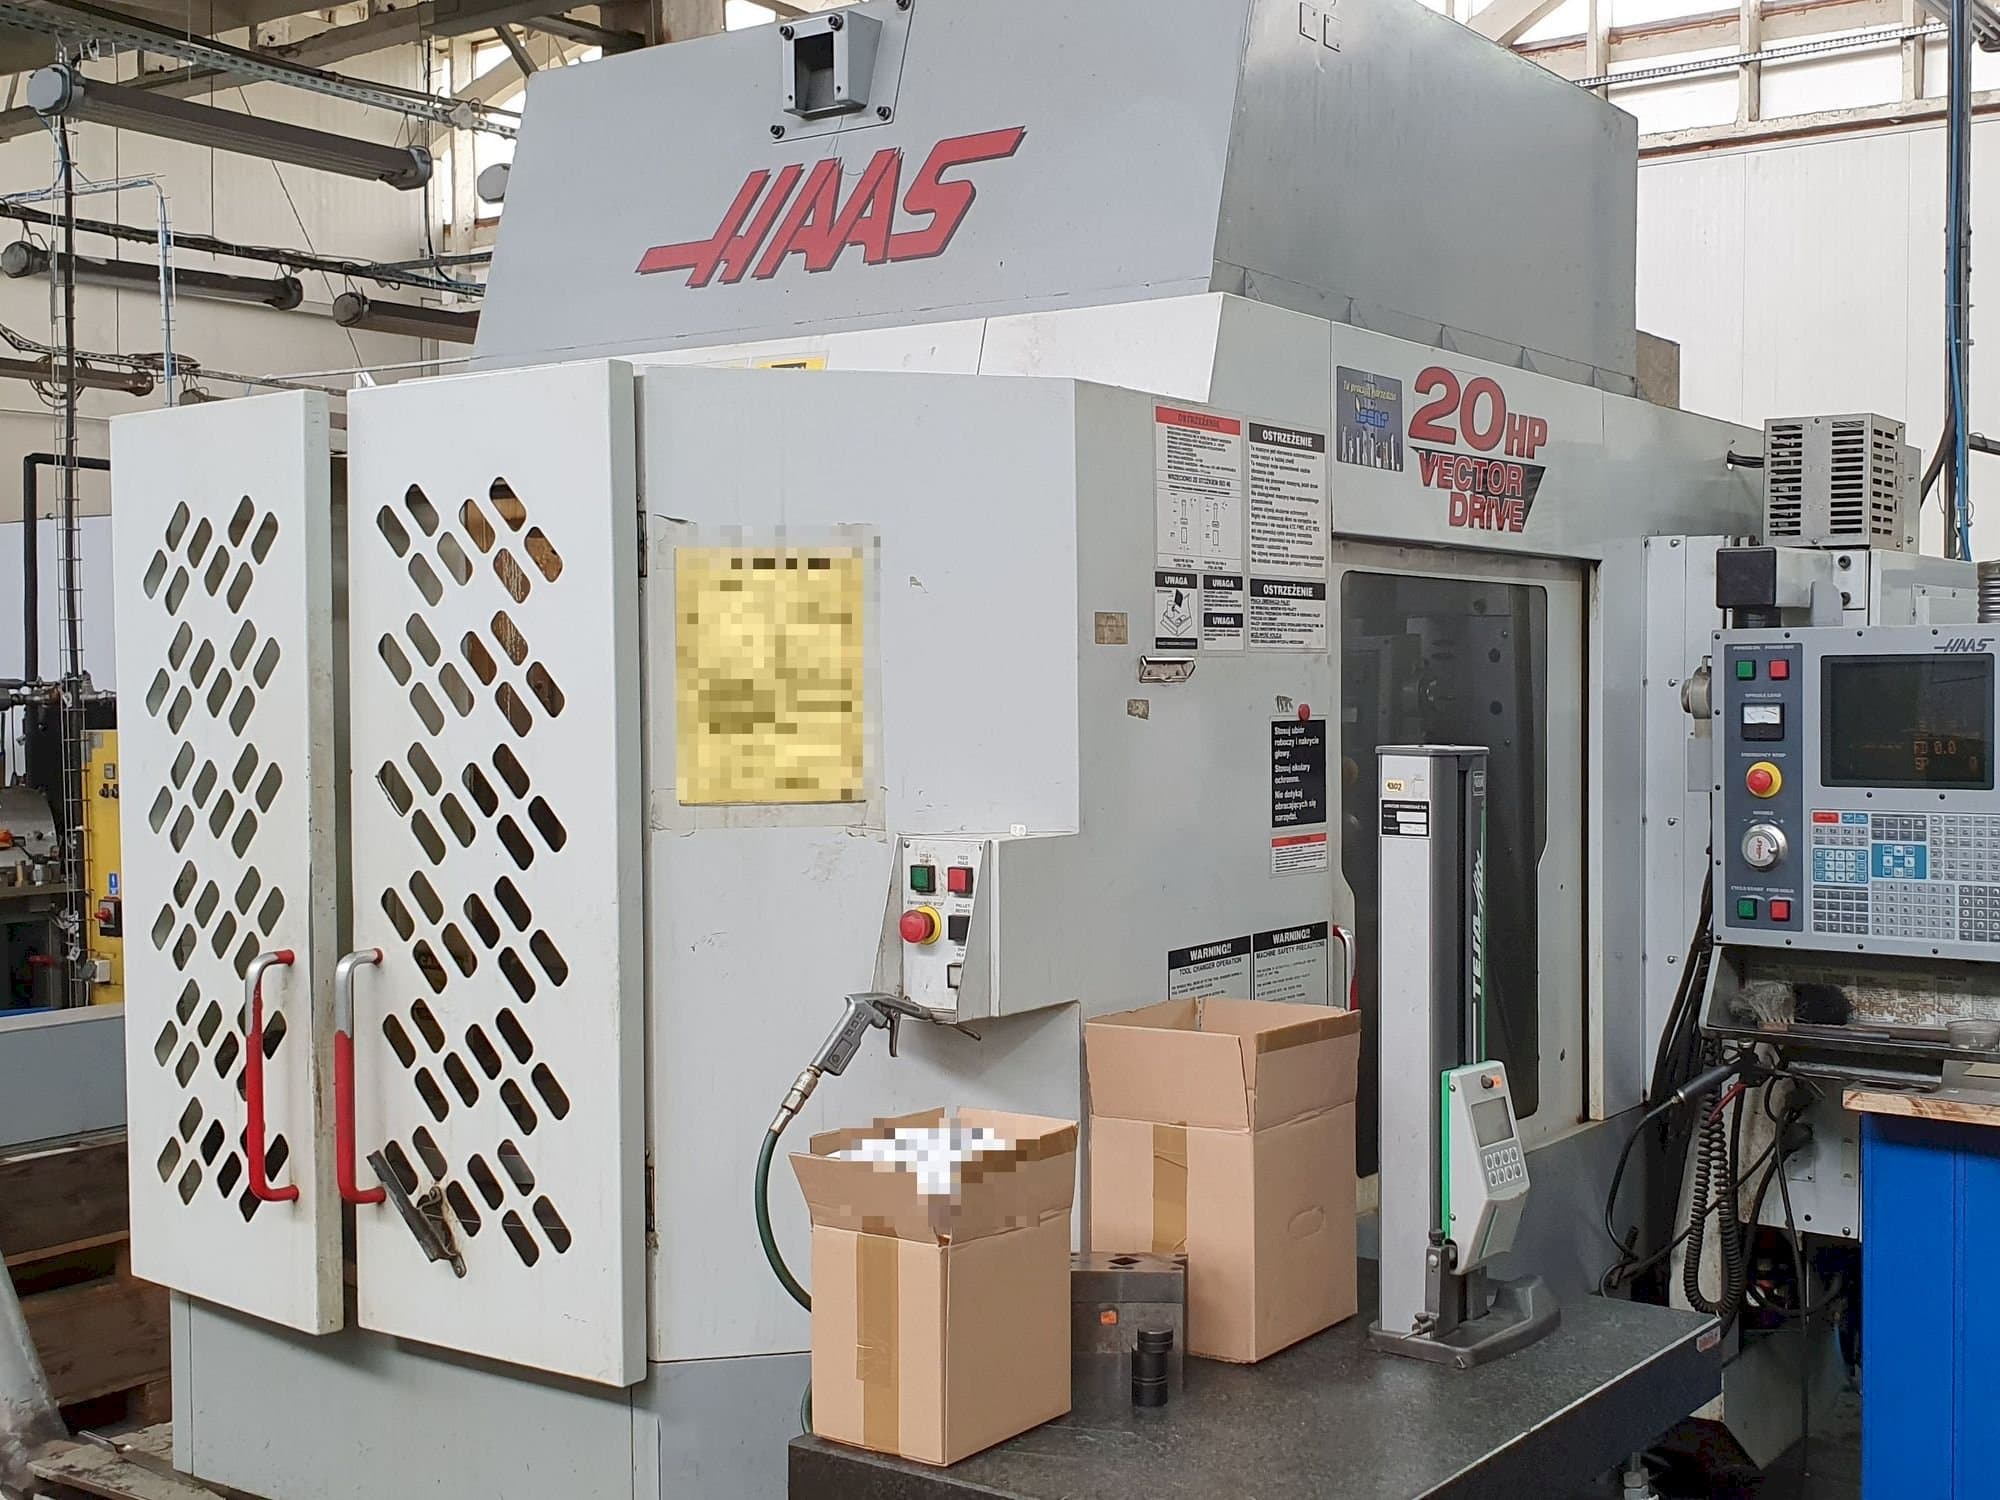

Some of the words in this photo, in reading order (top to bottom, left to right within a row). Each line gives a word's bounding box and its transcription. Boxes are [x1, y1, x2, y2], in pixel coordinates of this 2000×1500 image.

[635, 125, 1026, 288] HAAS
[1262, 429, 1313, 448] OSTRZEŻENIE
[1418, 450, 1525, 496] VECTOR
[1448, 491, 1525, 533] DRIVE
[1164, 575, 1188, 585] UWAGA
[1212, 578, 1234, 588] UWAGA
[1263, 583, 1313, 597] OSTRZEŻENIE
[1212, 616, 1235, 625] UWAGA
[1934, 638, 1995, 652] HAAS
